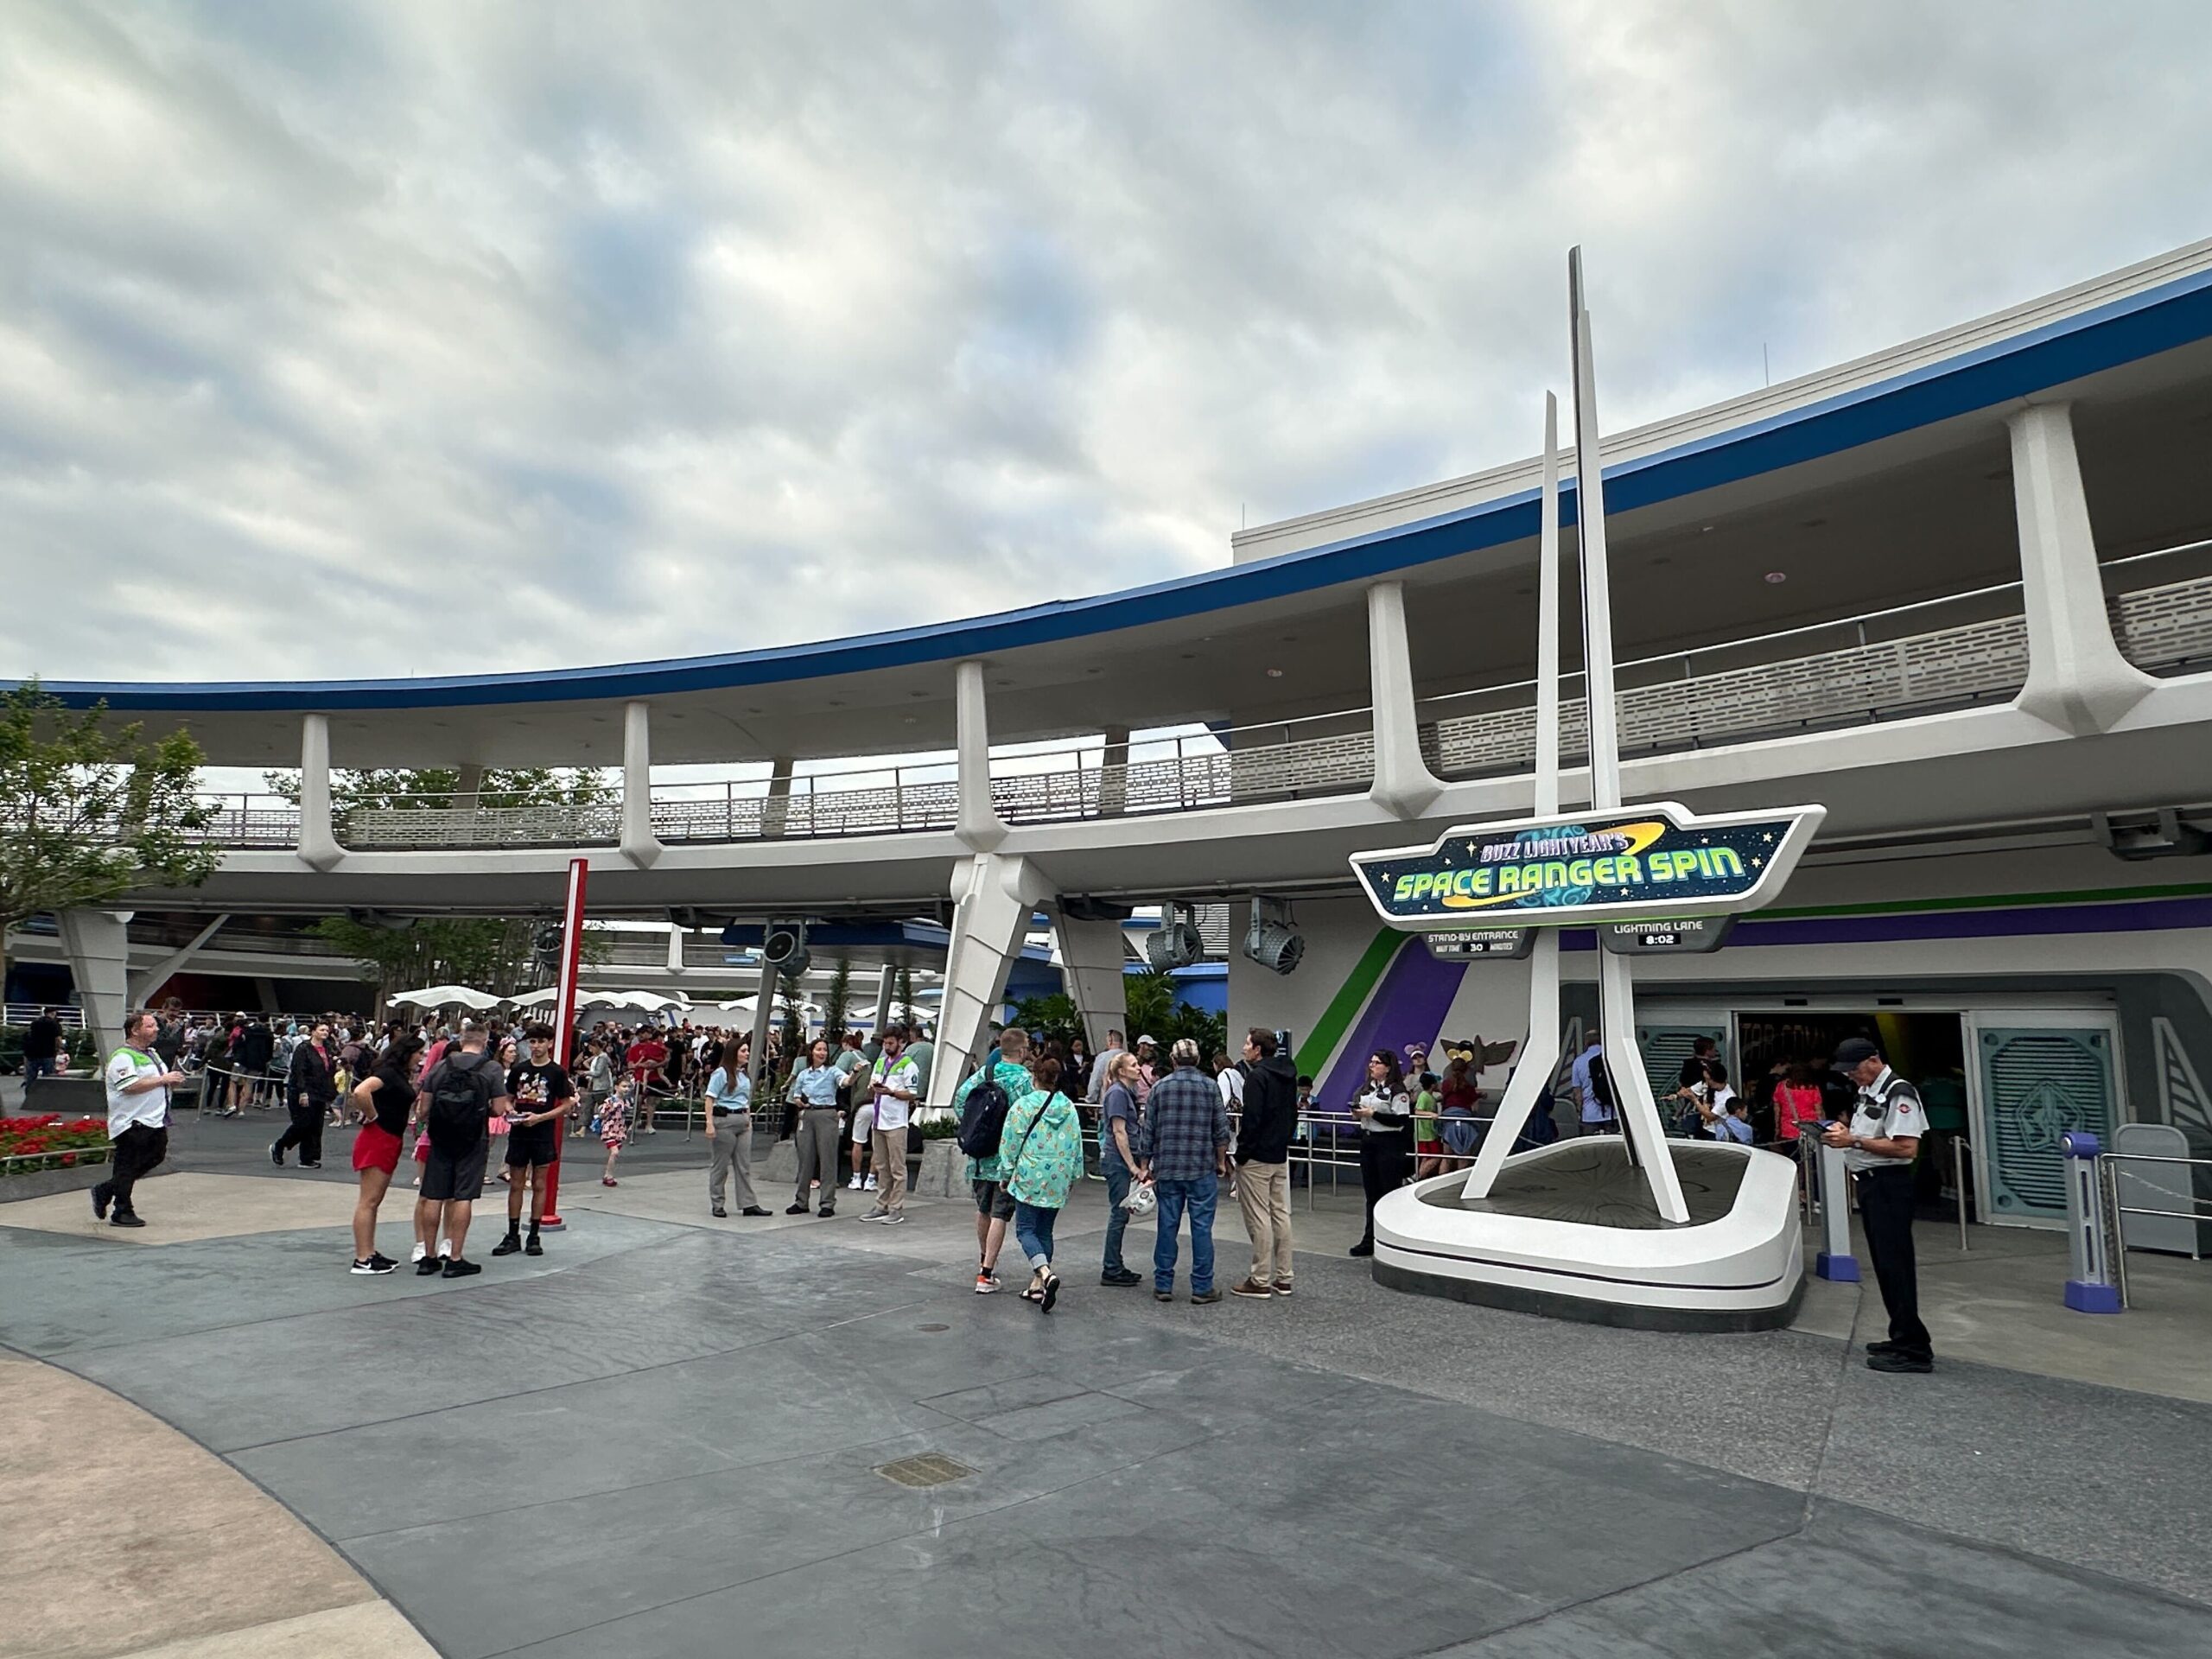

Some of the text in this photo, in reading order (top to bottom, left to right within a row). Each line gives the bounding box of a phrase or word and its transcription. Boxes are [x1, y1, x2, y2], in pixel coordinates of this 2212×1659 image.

[1480, 832, 1630, 862] BUZZ LIGHTYEAR'S
[1394, 847, 1744, 900] SPACE RANGER SPIN
[1614, 920, 1703, 934] LIGHTNING LANE
[1471, 931, 1518, 941] ENTRANCE
[1646, 935, 1674, 944] 8:02
[1470, 944, 1483, 952] 30
